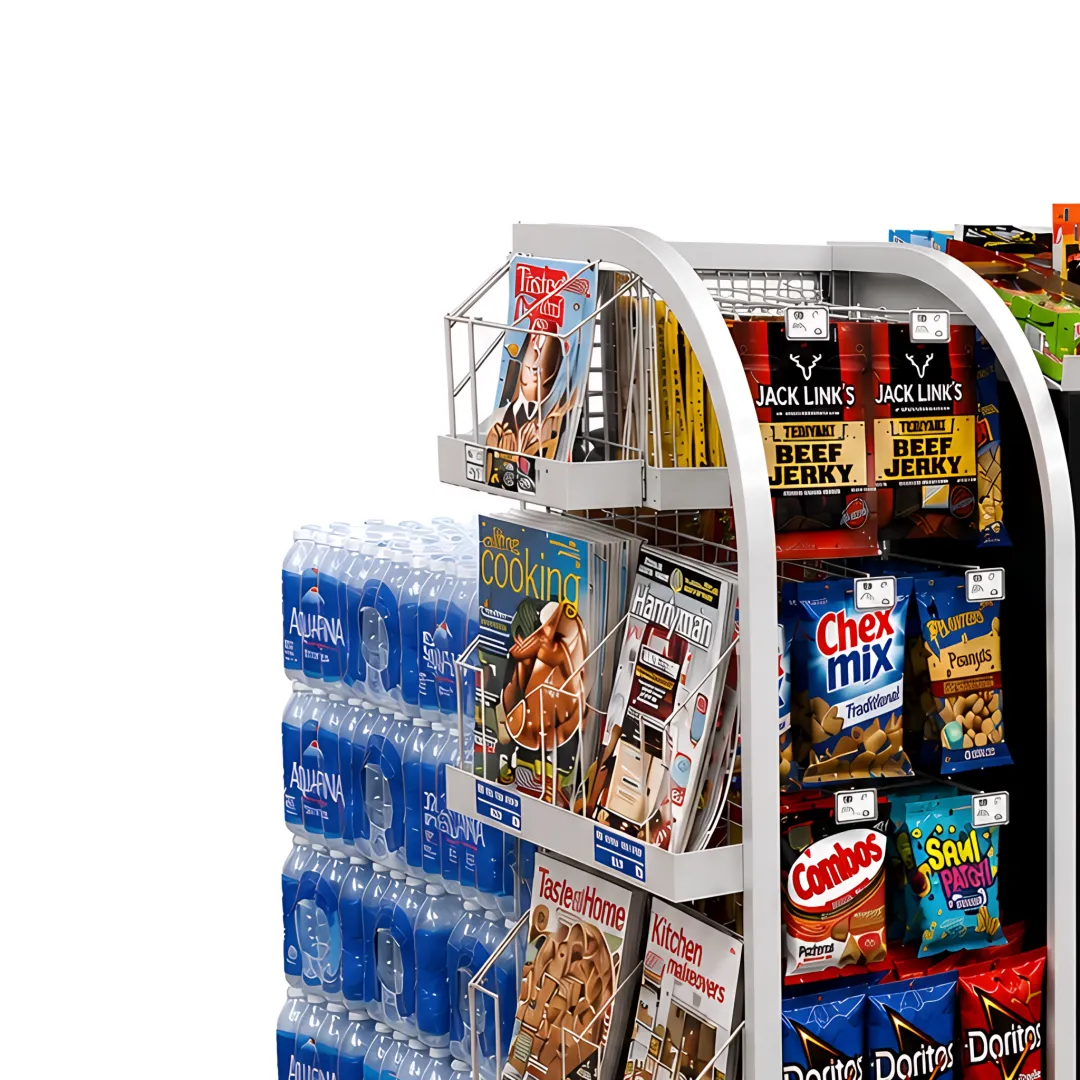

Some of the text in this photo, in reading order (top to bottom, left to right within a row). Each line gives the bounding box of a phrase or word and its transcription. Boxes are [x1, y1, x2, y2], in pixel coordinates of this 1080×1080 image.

[756, 382, 856, 406] JACK LINK'S
[875, 381, 963, 404] JACK LINK'S
[776, 443, 842, 464] BEEF
[893, 437, 952, 457] BEEF
[769, 464, 853, 486] JERKY
[884, 455, 962, 477] JERKY
[481, 548, 582, 618] cooking
[817, 606, 896, 657] Chex
[827, 637, 895, 693] mix
[792, 832, 883, 901] Combos
[651, 913, 703, 967] Kitchen
[968, 1022, 1042, 1064] Doritos
